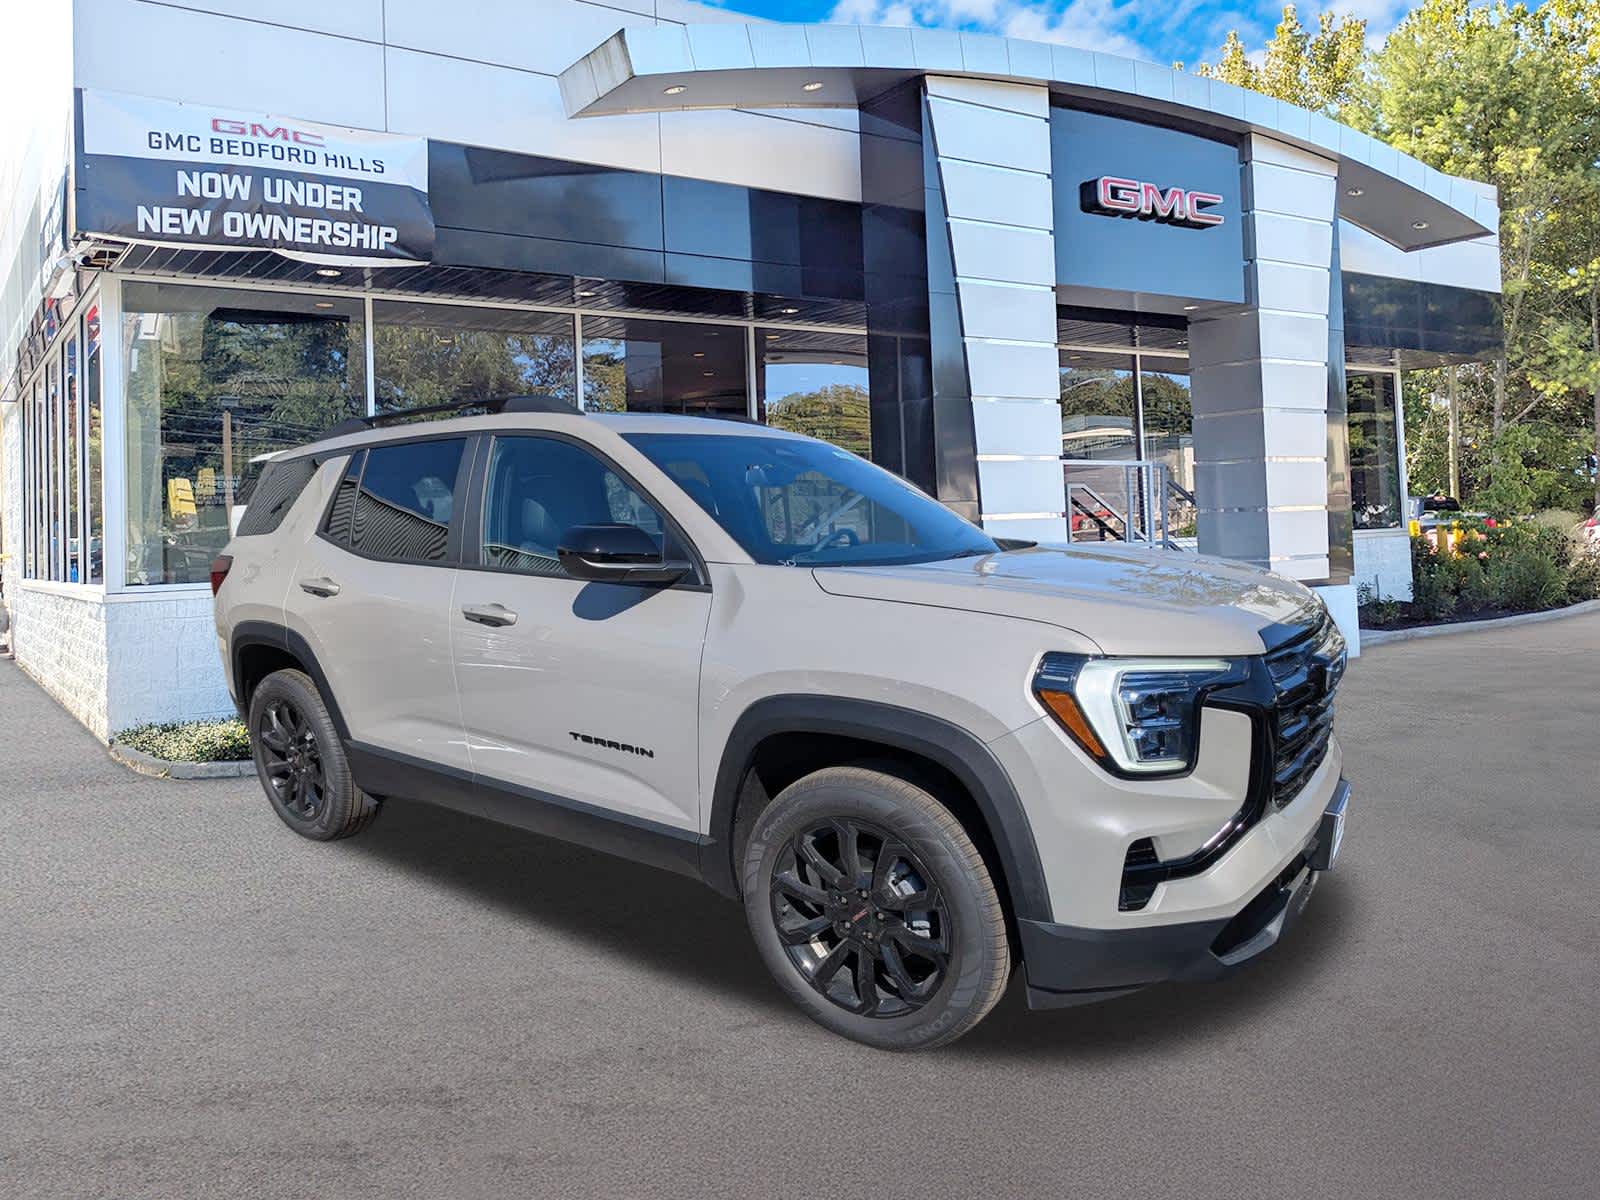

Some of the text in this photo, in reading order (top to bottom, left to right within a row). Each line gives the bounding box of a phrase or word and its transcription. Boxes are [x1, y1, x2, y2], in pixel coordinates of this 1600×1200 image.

[147, 131, 385, 174] GMC BEDFORD HILLS
[211, 118, 326, 148] GMC
[176, 170, 364, 213] NOW UNDER
[1095, 175, 1225, 226] GMC
[136, 205, 398, 250] NEW OWNERSHIP
[568, 731, 654, 758] TERRAIN
